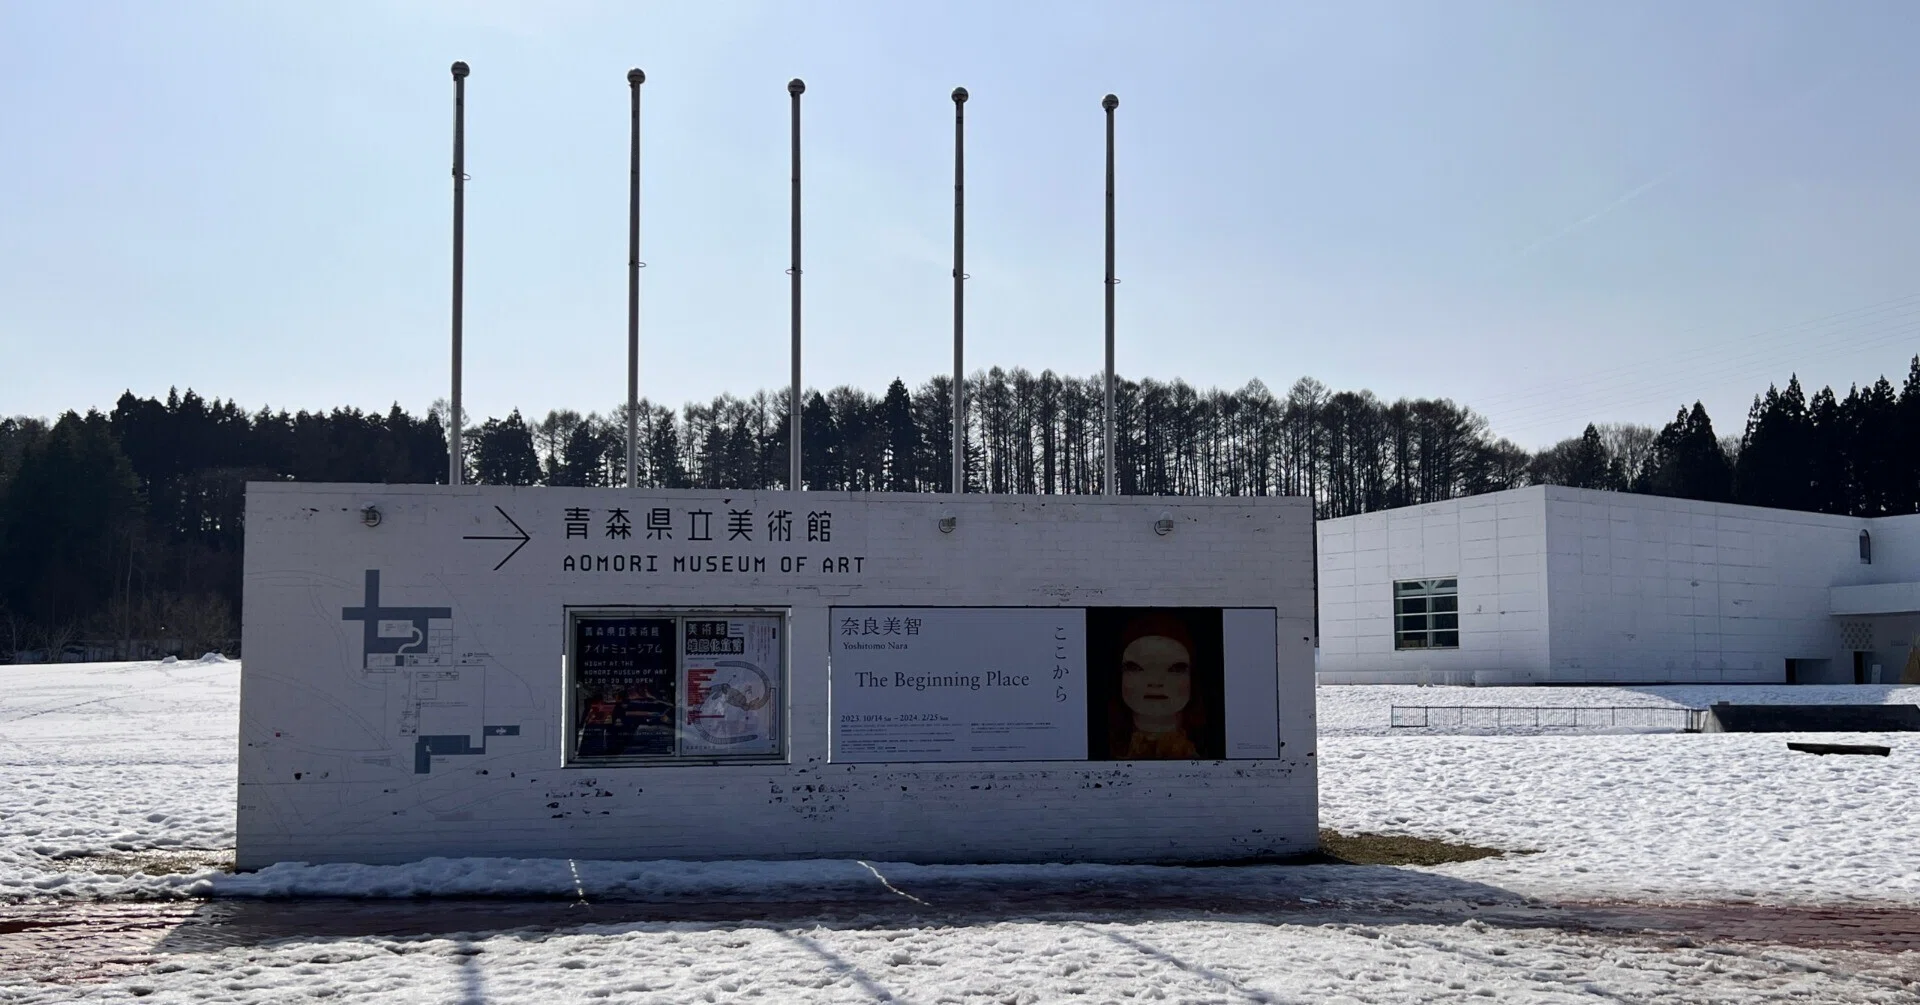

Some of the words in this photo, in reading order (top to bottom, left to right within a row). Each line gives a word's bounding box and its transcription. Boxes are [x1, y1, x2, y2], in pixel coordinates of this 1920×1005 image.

[564, 507, 832, 542] 青森県立美術館
[563, 554, 658, 572] AOMORI
[673, 555, 766, 573] MUSEUM
[780, 556, 807, 574] OF
[822, 556, 865, 573] ART
[840, 616, 922, 636] 奈良美智
[584, 643, 663, 654] ナイトミュージアム
[842, 641, 886, 650] Yoshitomo
[888, 641, 908, 650] Nara
[1052, 626, 1070, 703] ここから
[855, 671, 888, 688] The
[894, 671, 982, 692] Beginning
[986, 670, 1030, 687] Place
